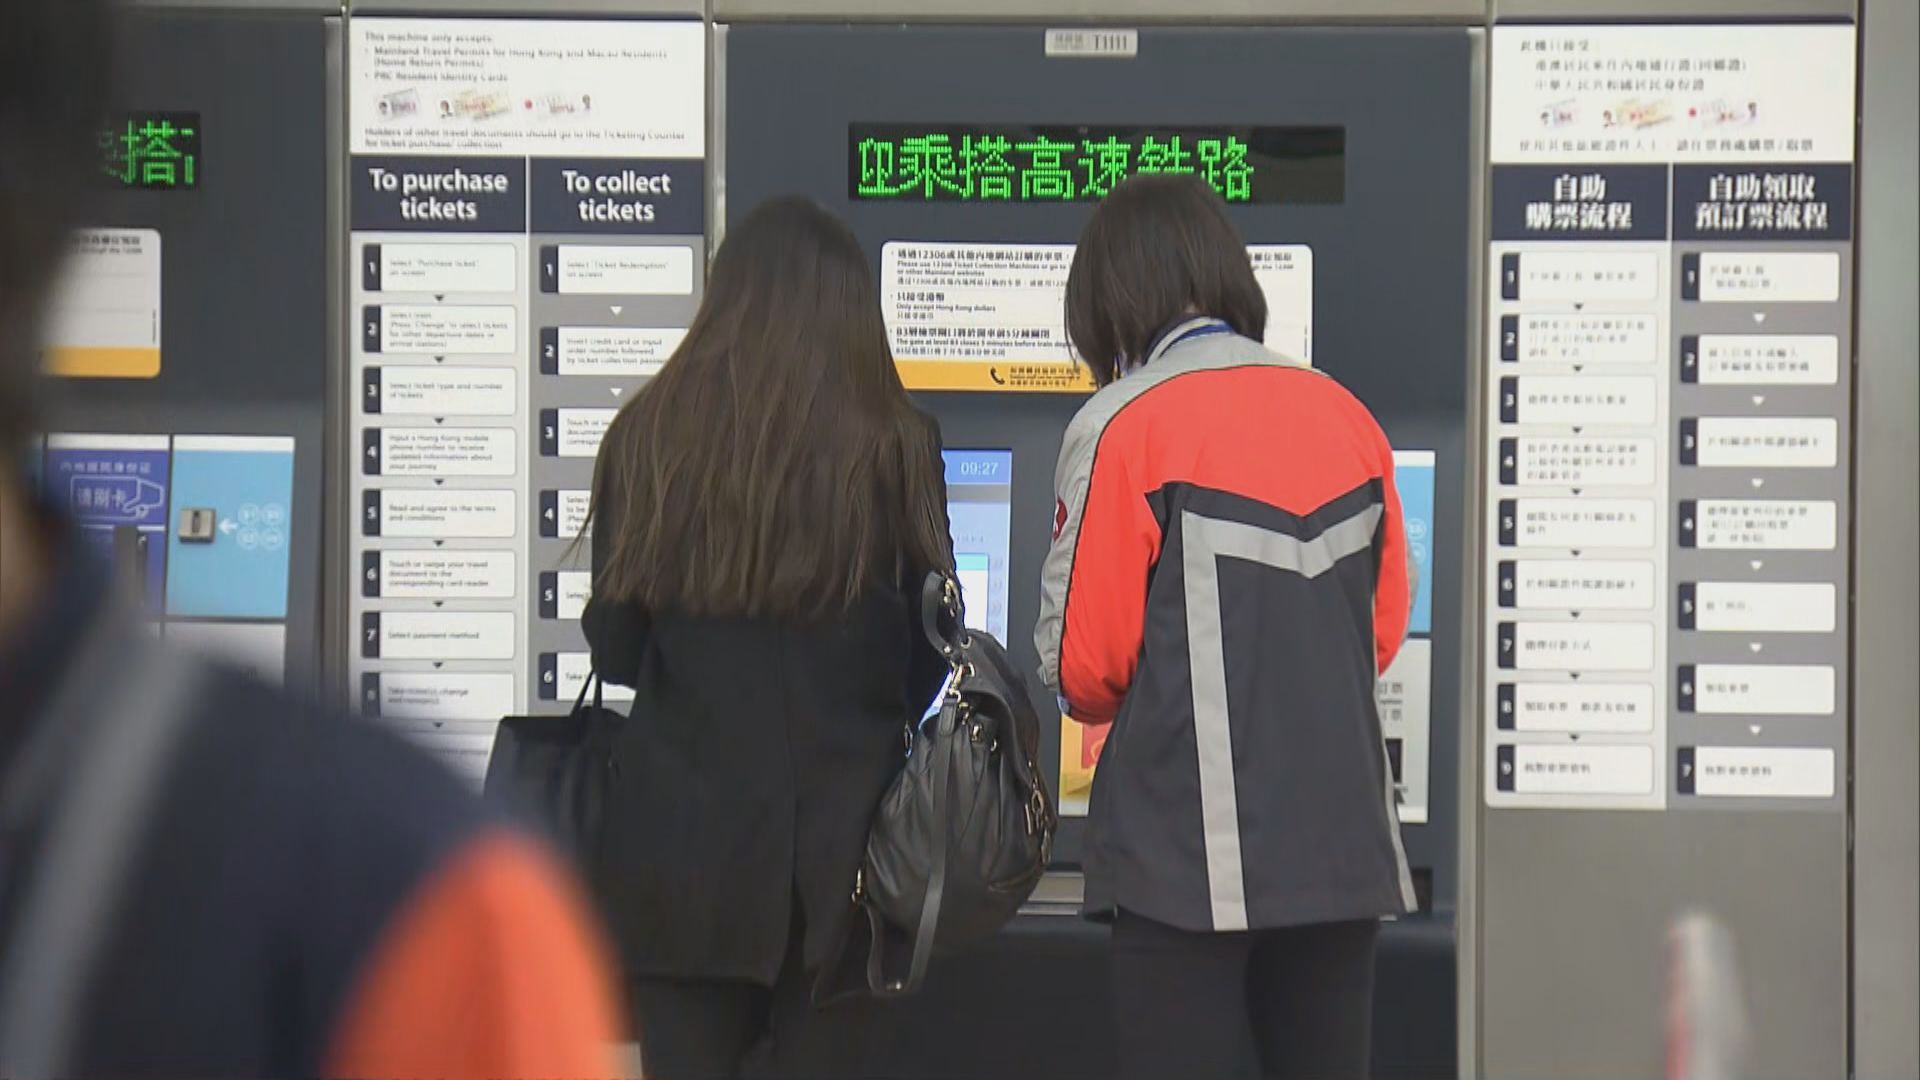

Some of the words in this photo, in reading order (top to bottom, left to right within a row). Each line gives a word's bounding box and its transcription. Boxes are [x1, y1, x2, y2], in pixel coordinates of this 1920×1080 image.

[365, 31, 385, 41] This
[388, 31, 428, 42] machine
[374, 46, 420, 55] Mainland
[422, 47, 450, 56] Travel
[369, 167, 398, 192] To
[402, 168, 509, 200] purchase
[562, 169, 590, 193] To
[594, 169, 672, 194] collect
[1553, 173, 1606, 200] 自助
[1709, 174, 1816, 200] 自助領取
[400, 196, 478, 219] tickets
[578, 198, 655, 221] tickets
[1525, 202, 1633, 230] 購票流程
[1695, 202, 1829, 230] 預訂票流程
[368, 261, 376, 275] 1
[546, 263, 553, 276] 1
[897, 260, 918, 268] Please
[896, 302, 912, 313] Only
[913, 303, 934, 313] accept
[936, 303, 953, 313] Hong
[955, 304, 972, 314] Kong
[973, 304, 996, 313] dollars
[368, 322, 377, 336] 2
[896, 337, 908, 346] The
[909, 338, 924, 348] gate
[933, 338, 949, 347] level
[1505, 332, 1515, 346] 2
[545, 344, 554, 358] 2
[368, 384, 377, 397] 3
[545, 426, 554, 439] 3
[367, 445, 377, 458] 4
[1503, 455, 1514, 467] 4
[960, 462, 998, 476] 09:27
[367, 506, 377, 520] 5
[544, 507, 554, 520] 4
[367, 567, 377, 581] 6
[1502, 578, 1513, 591] 6
[544, 589, 553, 602] 5
[367, 628, 376, 641] 7
[1503, 638, 1513, 652] 7
[543, 670, 553, 683] 6
[1501, 761, 1512, 775] 9
